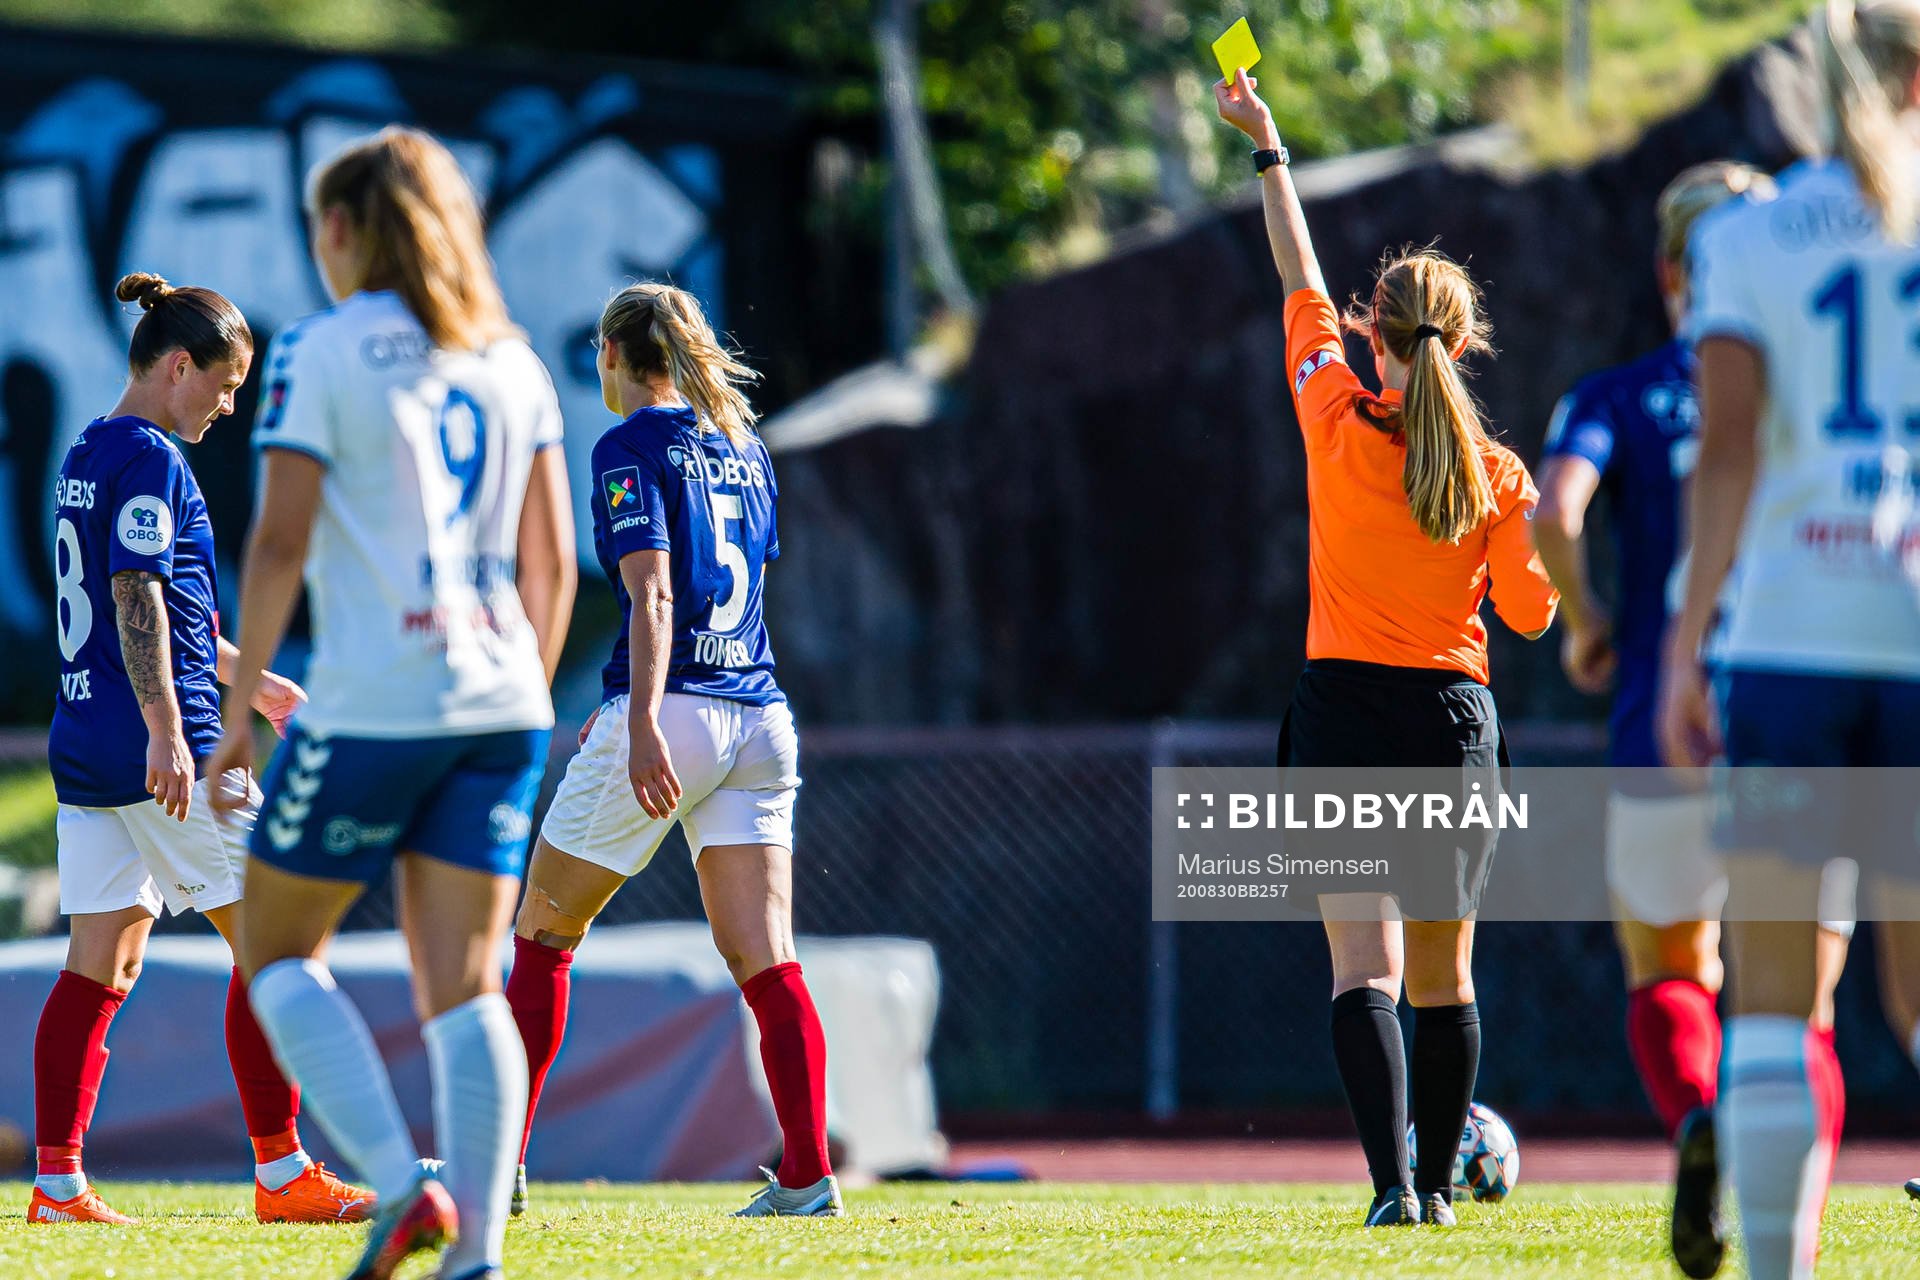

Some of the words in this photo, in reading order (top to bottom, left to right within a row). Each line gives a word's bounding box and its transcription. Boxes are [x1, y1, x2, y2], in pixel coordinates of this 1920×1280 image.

[438, 387, 486, 524] 9
[612, 514, 649, 534] umbro
[55, 518, 93, 662] 8
[126, 529, 164, 543] OBOS
[708, 493, 749, 632] 5
